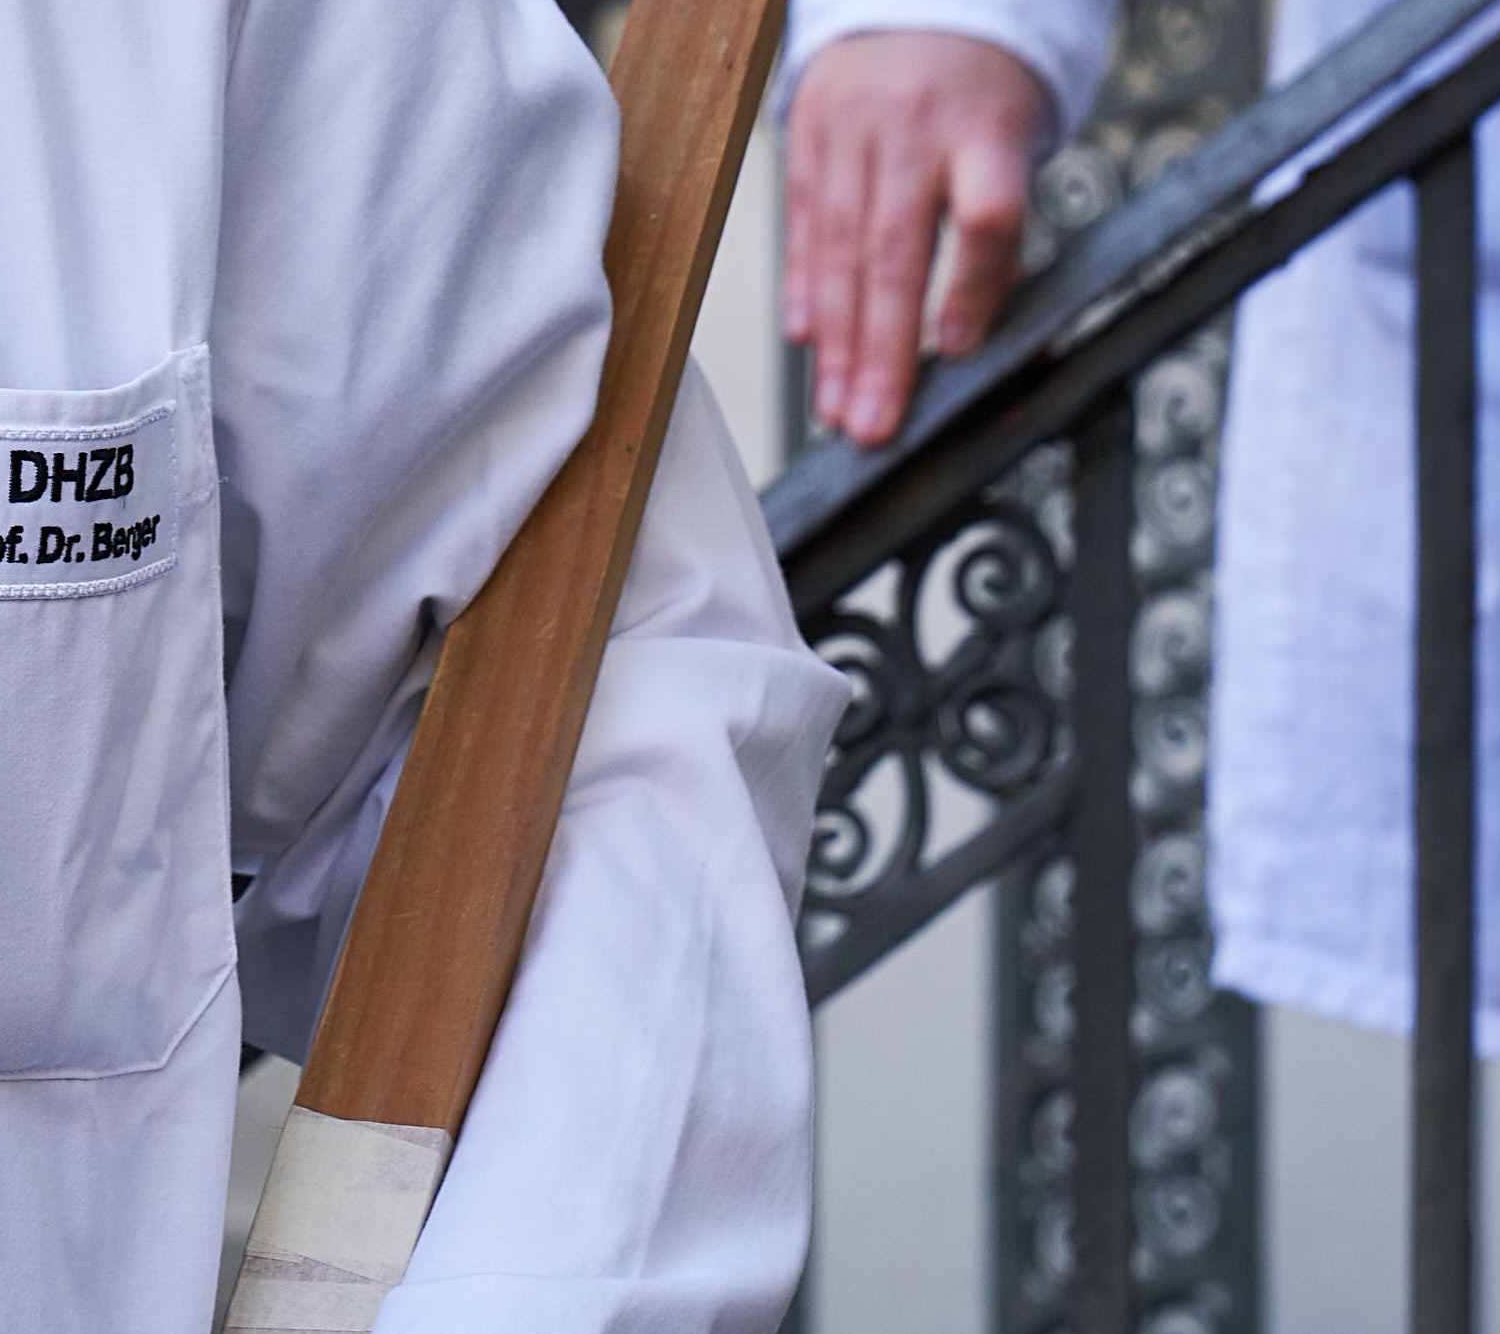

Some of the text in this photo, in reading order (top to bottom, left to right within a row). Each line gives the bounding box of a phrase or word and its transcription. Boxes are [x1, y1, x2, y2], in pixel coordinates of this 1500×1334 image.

[8, 443, 135, 504] DHZB
[36, 525, 85, 564] Dr.
[90, 514, 161, 561] Berger
